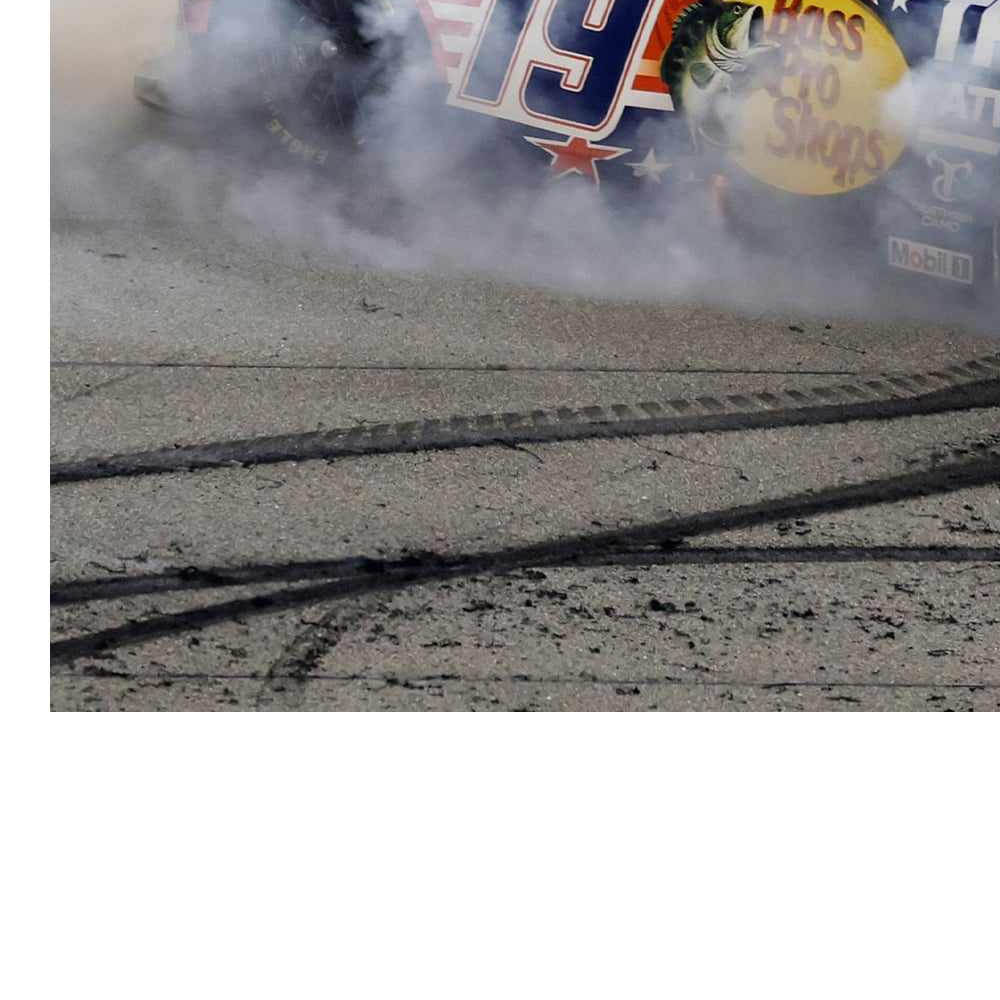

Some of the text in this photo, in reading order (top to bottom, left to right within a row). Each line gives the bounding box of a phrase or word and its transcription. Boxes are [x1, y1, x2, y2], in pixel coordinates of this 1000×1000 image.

[764, 44, 841, 110] Pro
[765, 96, 886, 188] Shops
[891, 240, 947, 275] Mobil
